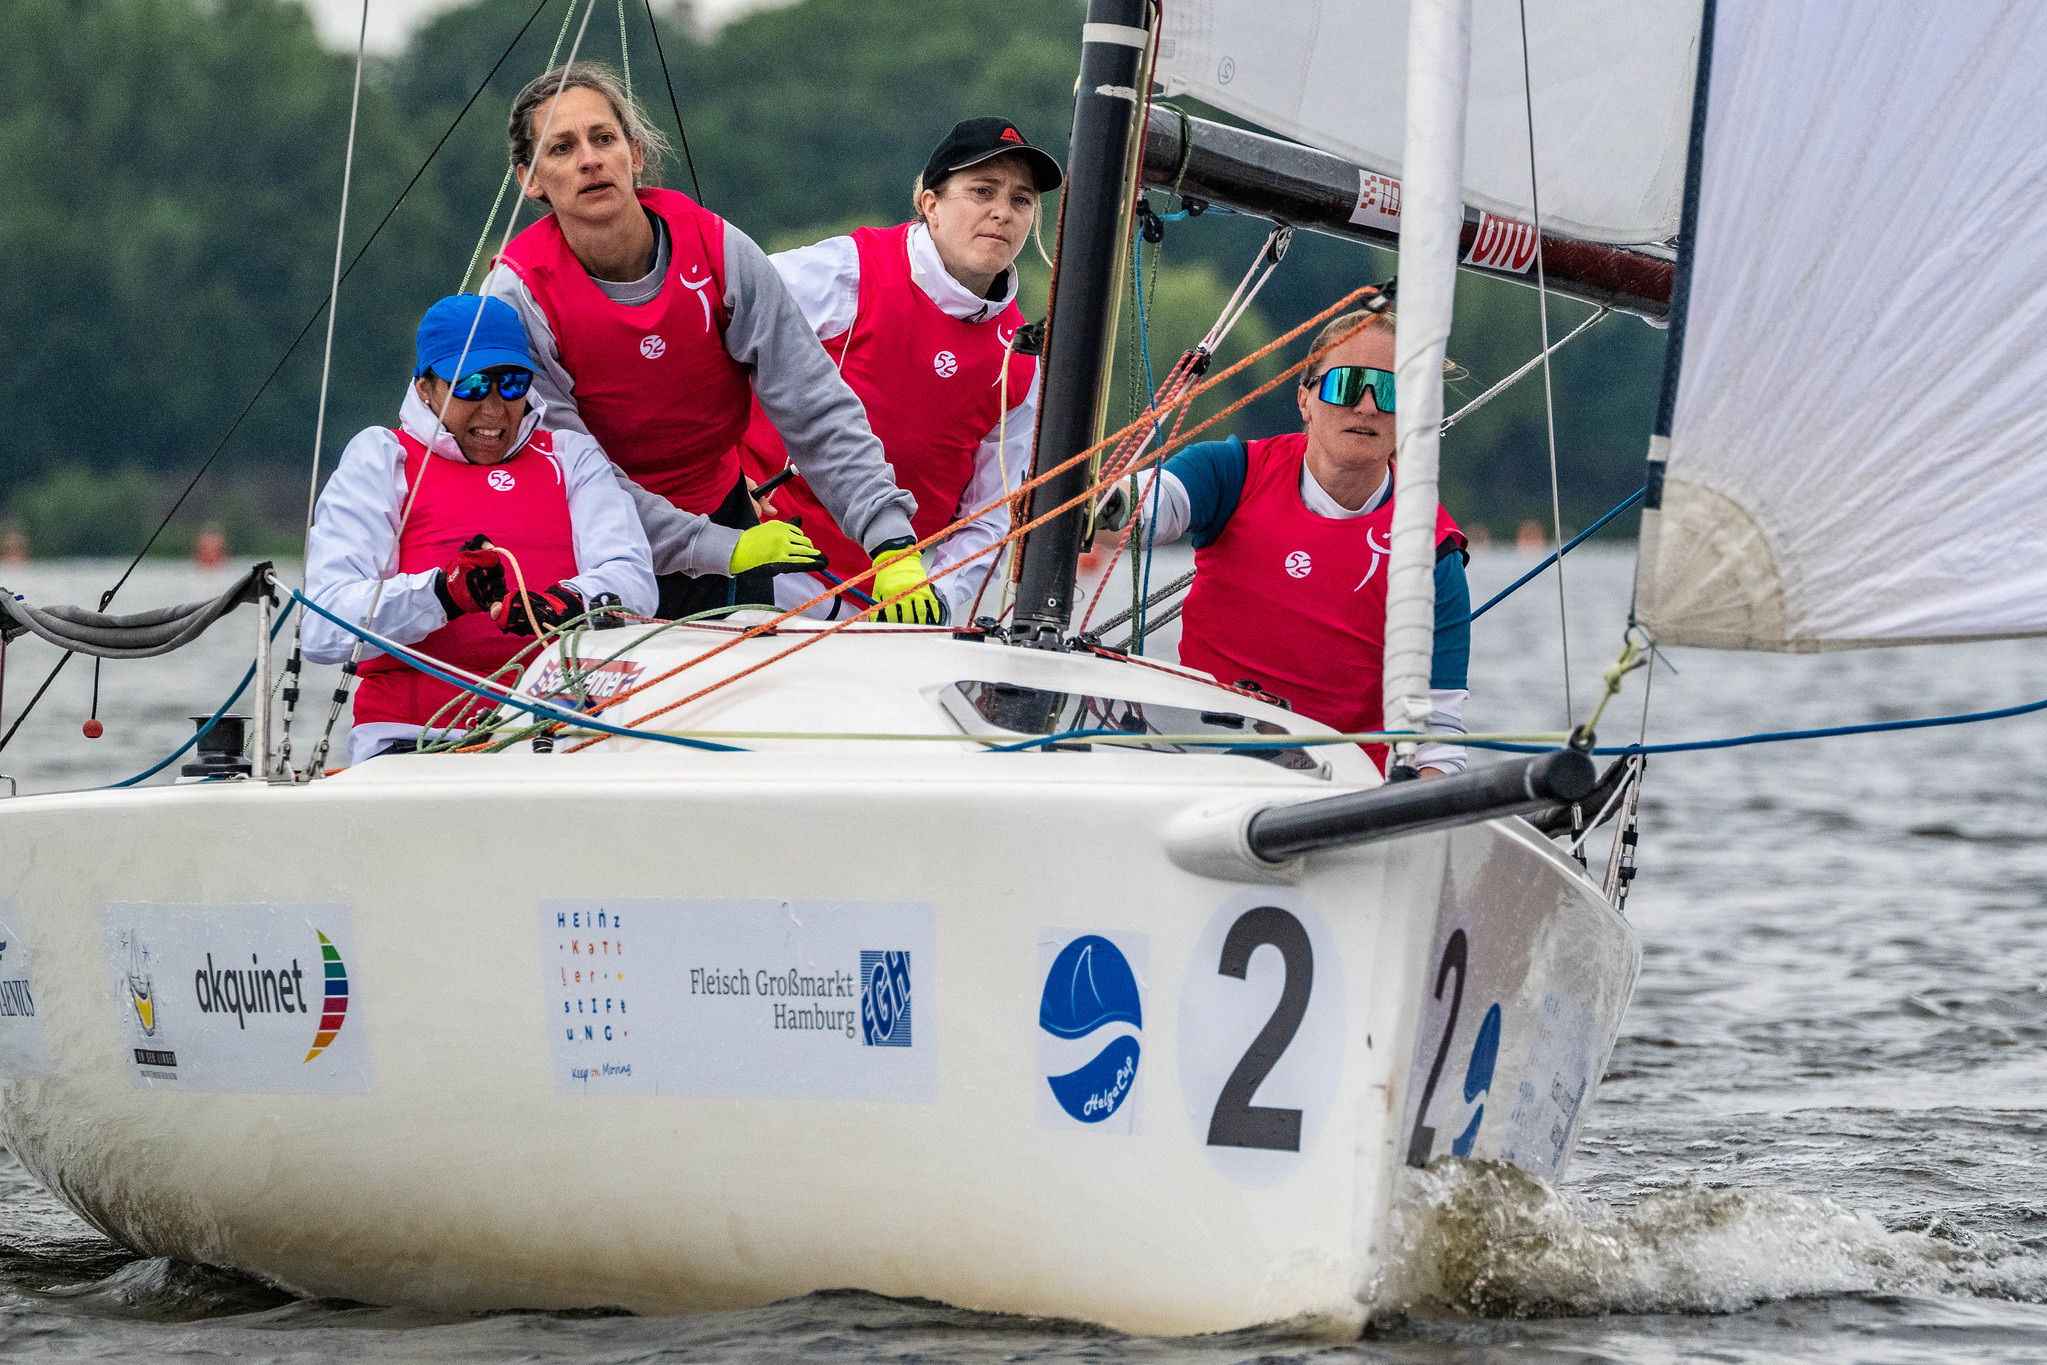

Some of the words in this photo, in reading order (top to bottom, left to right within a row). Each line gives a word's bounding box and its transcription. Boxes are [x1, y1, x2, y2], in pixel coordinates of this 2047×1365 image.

[642, 336, 664, 356] 52
[935, 353, 957, 375] 52
[490, 472, 513, 487] 52
[1286, 553, 1311, 576] 52
[195, 953, 307, 1029] akquinet
[690, 968, 750, 995] Fleisch
[755, 968, 854, 997] Großmarkt
[773, 1003, 856, 1039] Hamburg
[1206, 906, 1314, 1153] 2
[1406, 928, 1468, 1169] 2
[571, 1068, 588, 1082] Keep
[602, 1062, 631, 1076] Moving
